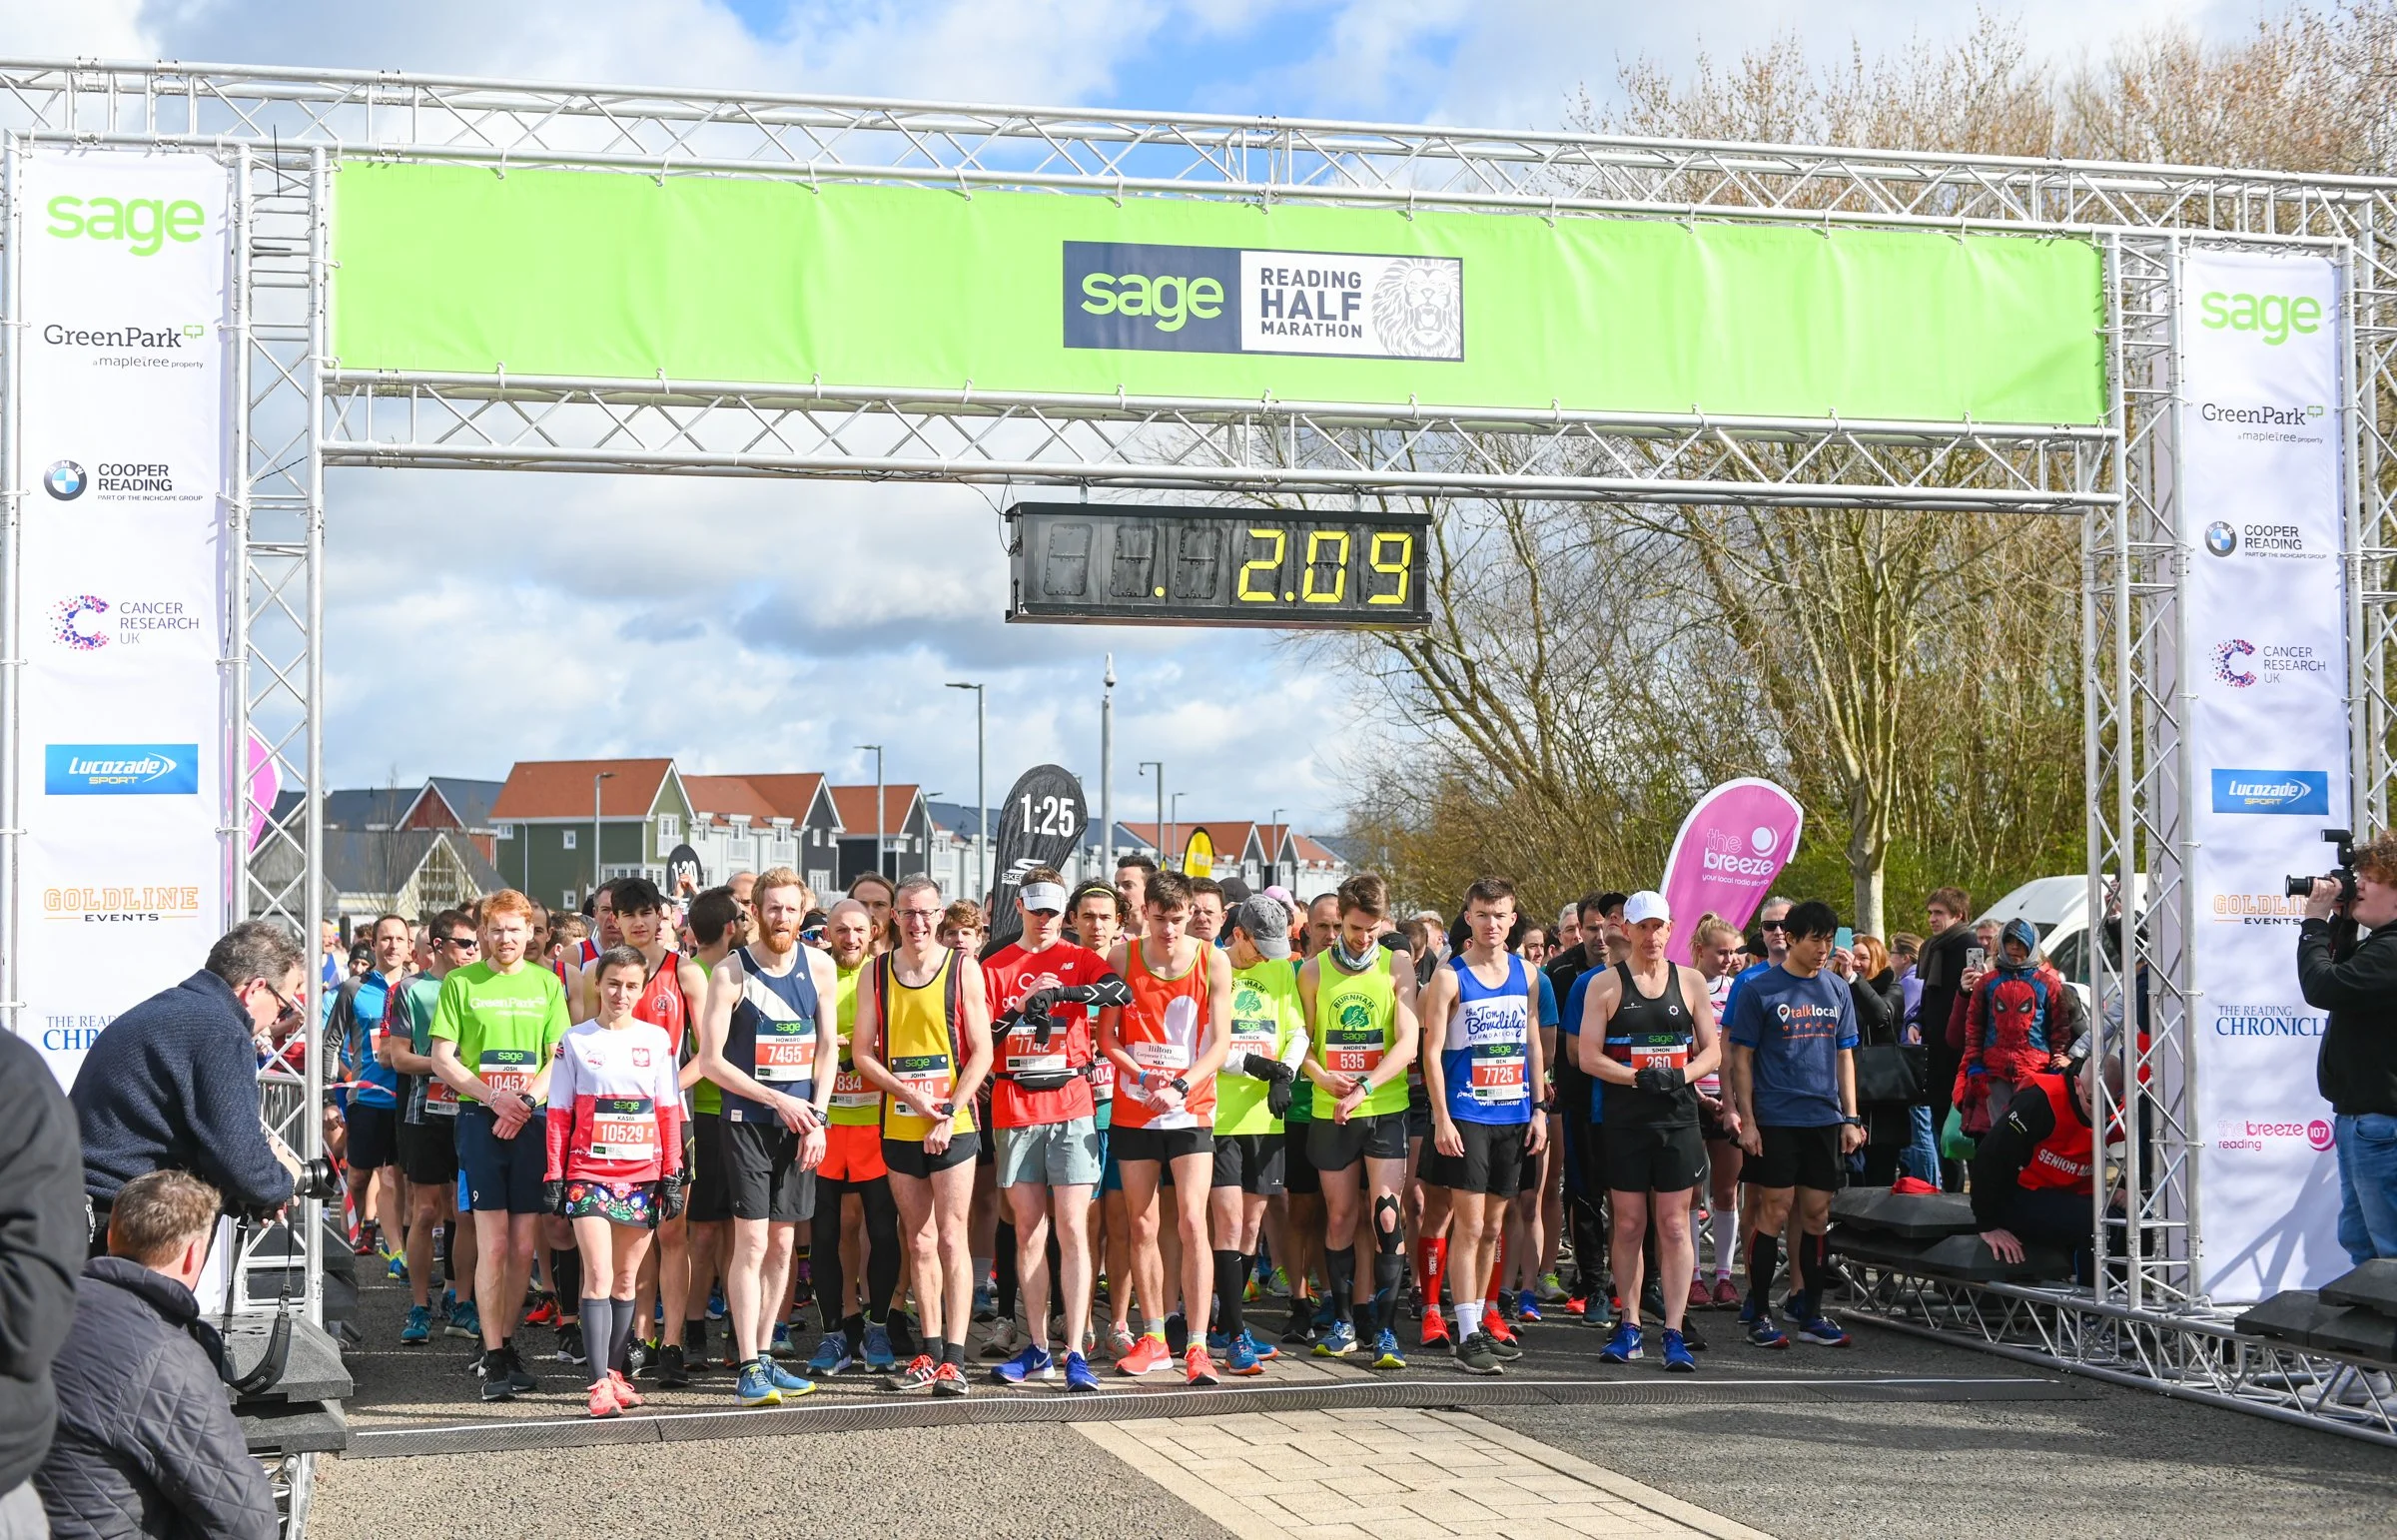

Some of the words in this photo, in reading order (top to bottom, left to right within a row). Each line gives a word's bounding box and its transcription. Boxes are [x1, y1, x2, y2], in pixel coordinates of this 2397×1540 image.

[45, 195, 206, 257] sage
[1260, 267, 1362, 290] READING
[1081, 272, 1224, 333] sage
[1260, 288, 1361, 322] HALF
[2200, 291, 2322, 346] sage
[43, 324, 182, 348] GreenPark
[1260, 322, 1363, 339] MARATHON
[99, 357, 170, 369] mapletree
[2201, 402, 2306, 425] GreenPark
[2242, 431, 2297, 442] mapletree
[98, 463, 170, 476] COOPER
[98, 478, 173, 491] READING
[2244, 524, 2299, 537] COOPER
[2244, 537, 2302, 550] READING
[1236, 528, 1414, 604] 2.09
[119, 601, 184, 615] CANCER
[119, 616, 200, 630] RESEARCH
[119, 631, 140, 645] UK
[2263, 645, 2313, 658] CANCER
[2263, 659, 2326, 672] RESEARCH
[2263, 672, 2281, 684] UK
[68, 756, 160, 776] Lucozade
[88, 776, 139, 785] SPORT
[2228, 779, 2298, 798] Lucozade
[2244, 797, 2283, 806] SPORT
[1021, 793, 1075, 837] 1:25
[1706, 828, 1743, 854] the
[1703, 847, 1775, 876] breeze
[1702, 873, 1717, 882] your
[1717, 875, 1734, 884] local
[1734, 877, 1751, 887] radio
[44, 886, 199, 911] GOLDLINE
[2213, 894, 2309, 916] GOLDLIN
[84, 913, 160, 922] EVENTS
[2244, 917, 2301, 926] EVENTS
[1333, 994, 1375, 1010] BURNHAM
[1465, 1007, 1478, 1018] the
[1477, 1005, 1500, 1021] Tom
[1790, 1004, 1838, 1019] talklocal
[2218, 1005, 2240, 1017] THE
[2243, 1005, 2292, 1017] READING
[46, 1015, 75, 1028] THE
[775, 1022, 801, 1034] sage
[1237, 1022, 1260, 1033] sage
[1464, 1010, 1527, 1038] Bowdidge
[2215, 1017, 2327, 1037] CHRONICL
[1341, 1033, 1367, 1042] sage
[1648, 1035, 1674, 1045] sage
[1016, 1037, 1050, 1054] 7742
[1148, 1045, 1174, 1055] Hilton
[1488, 1045, 1512, 1056] sage
[497, 1051, 524, 1063] sage
[767, 1045, 802, 1064] 7455
[1339, 1053, 1365, 1070] 535
[905, 1058, 931, 1070] sage
[1646, 1056, 1672, 1069] 260
[1483, 1067, 1514, 1084] 7725
[486, 1075, 528, 1093] 10452
[613, 1100, 640, 1112] sage
[600, 1124, 644, 1143] 10529
[2245, 1120, 2304, 1137] breeze
[2309, 1127, 2327, 1139] 107
[2218, 1139, 2262, 1152] reading
[2037, 1149, 2078, 1175] SENIOR
[472, 1189, 479, 1202] 9
